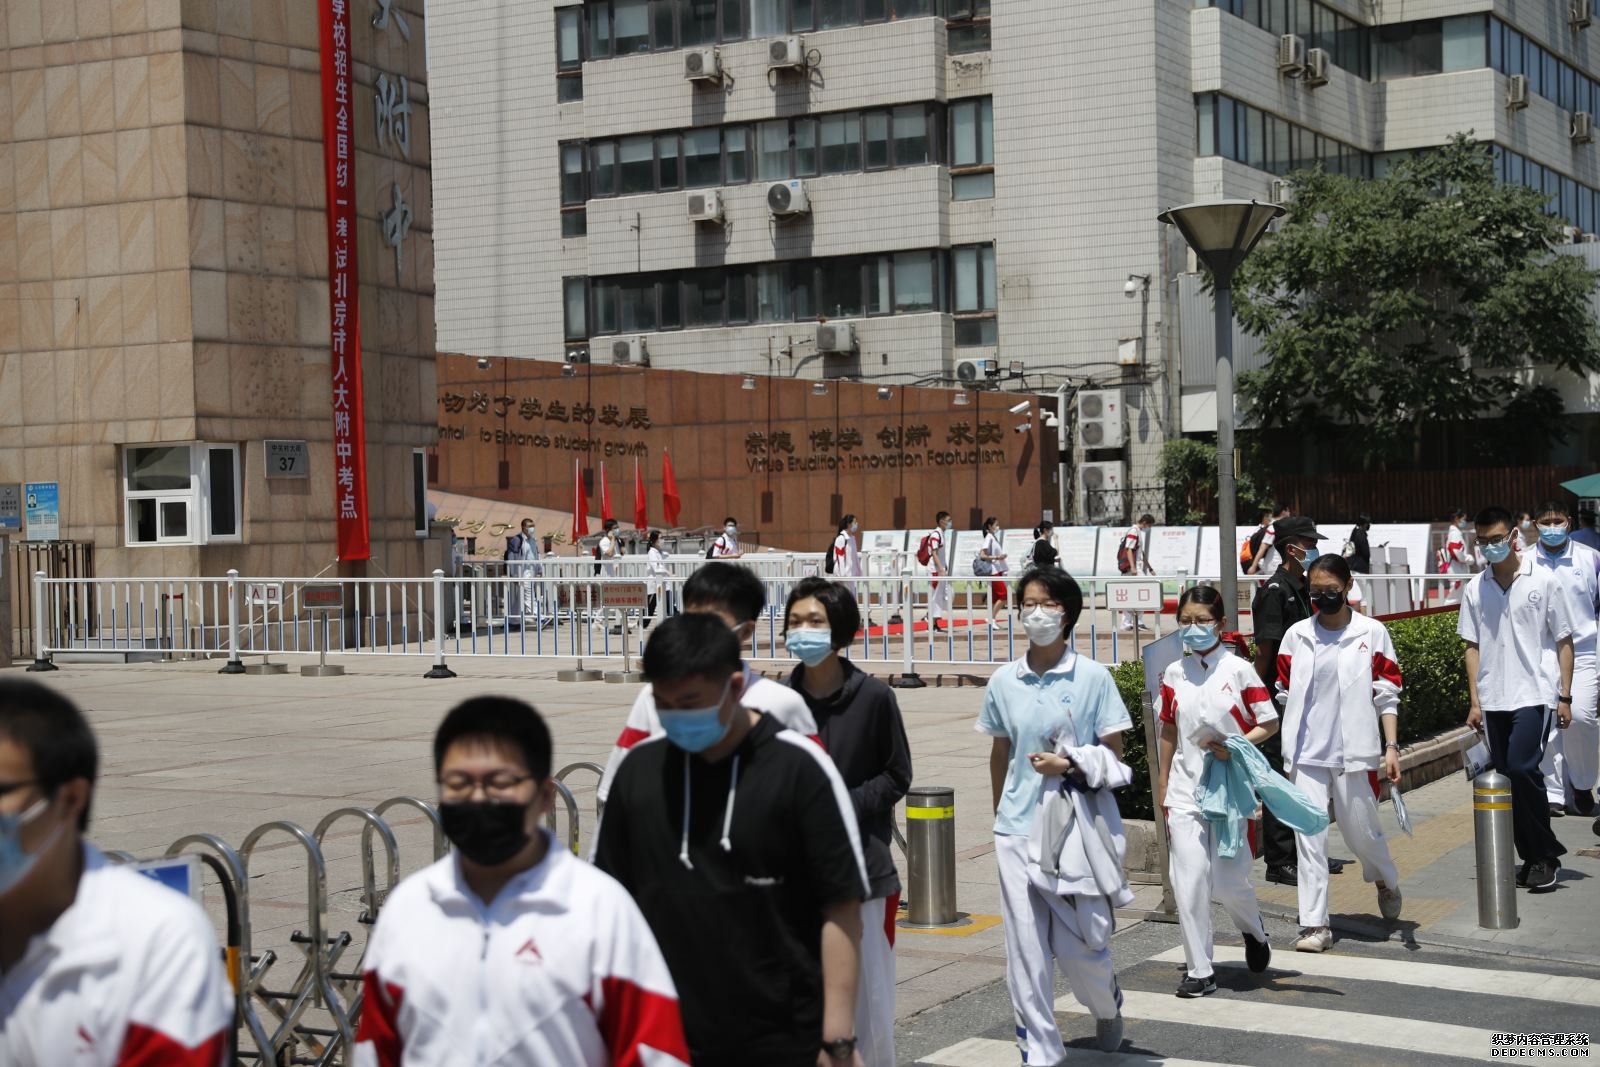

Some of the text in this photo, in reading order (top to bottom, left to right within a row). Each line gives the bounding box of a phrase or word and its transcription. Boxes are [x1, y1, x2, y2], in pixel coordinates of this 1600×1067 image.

[437, 391, 651, 430] 切为了学生的发展
[279, 457, 295, 471] 37
[1115, 588, 1150, 602] 出口
